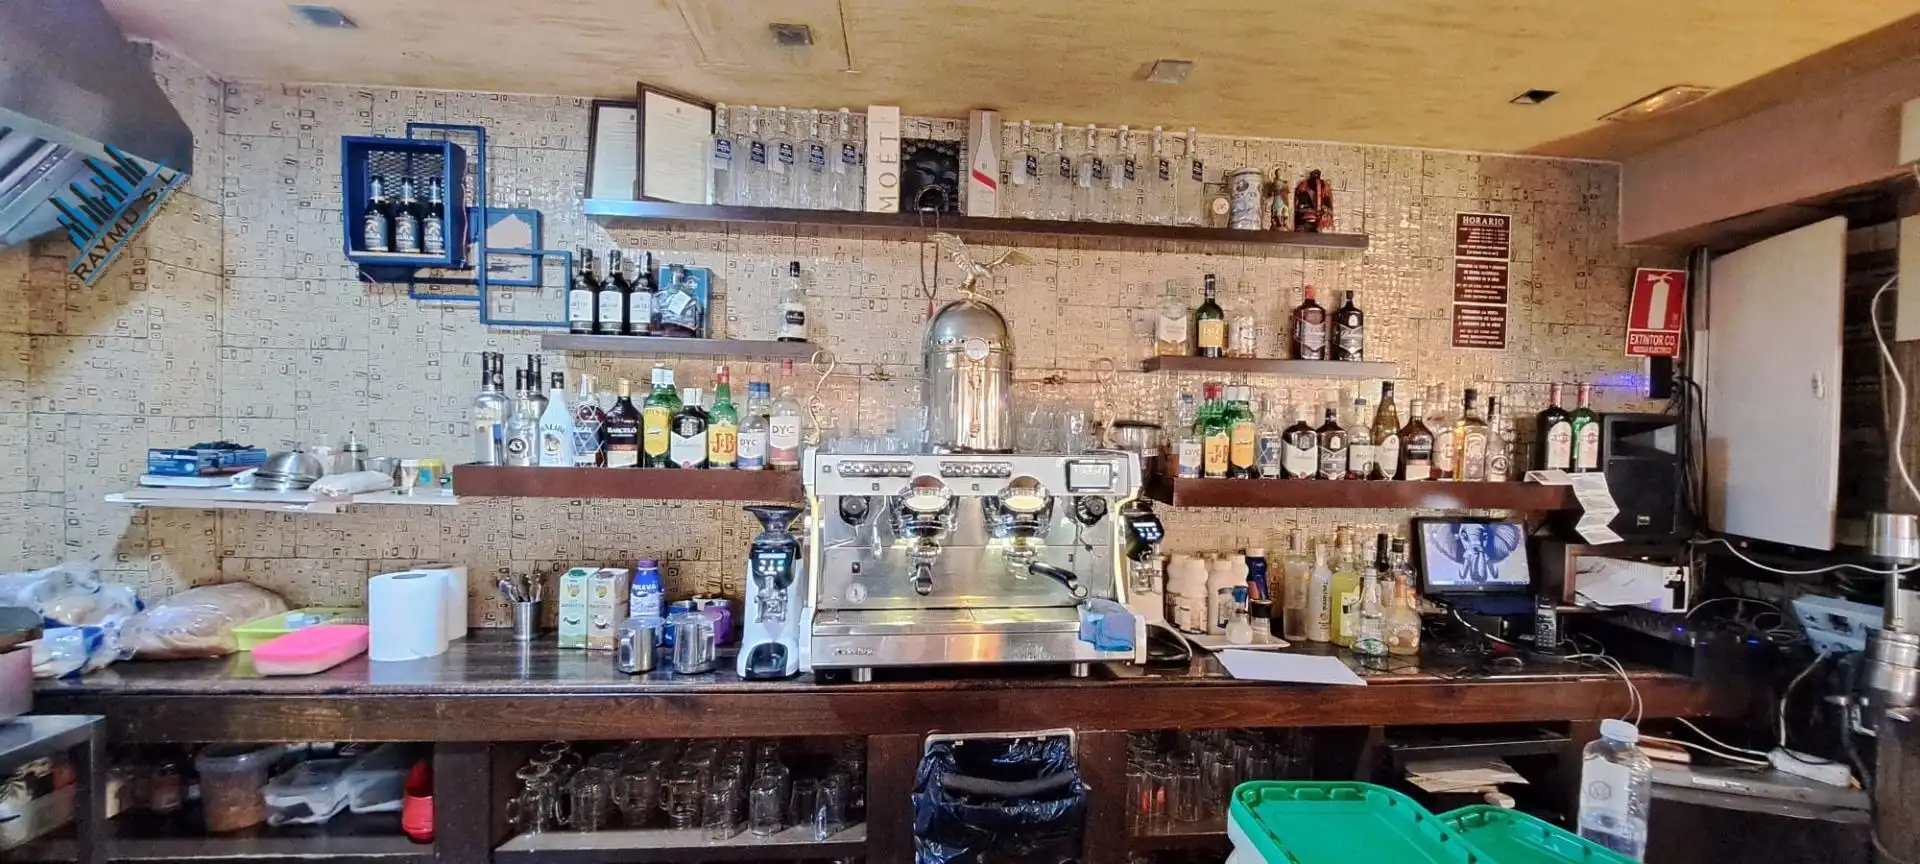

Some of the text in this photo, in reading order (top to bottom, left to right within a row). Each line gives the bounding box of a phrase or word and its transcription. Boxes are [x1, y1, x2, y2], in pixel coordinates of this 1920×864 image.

[1462, 215, 1505, 226] HORARIO
[1630, 333, 1665, 346] EXTINTOR
[772, 425, 796, 434] DYC
